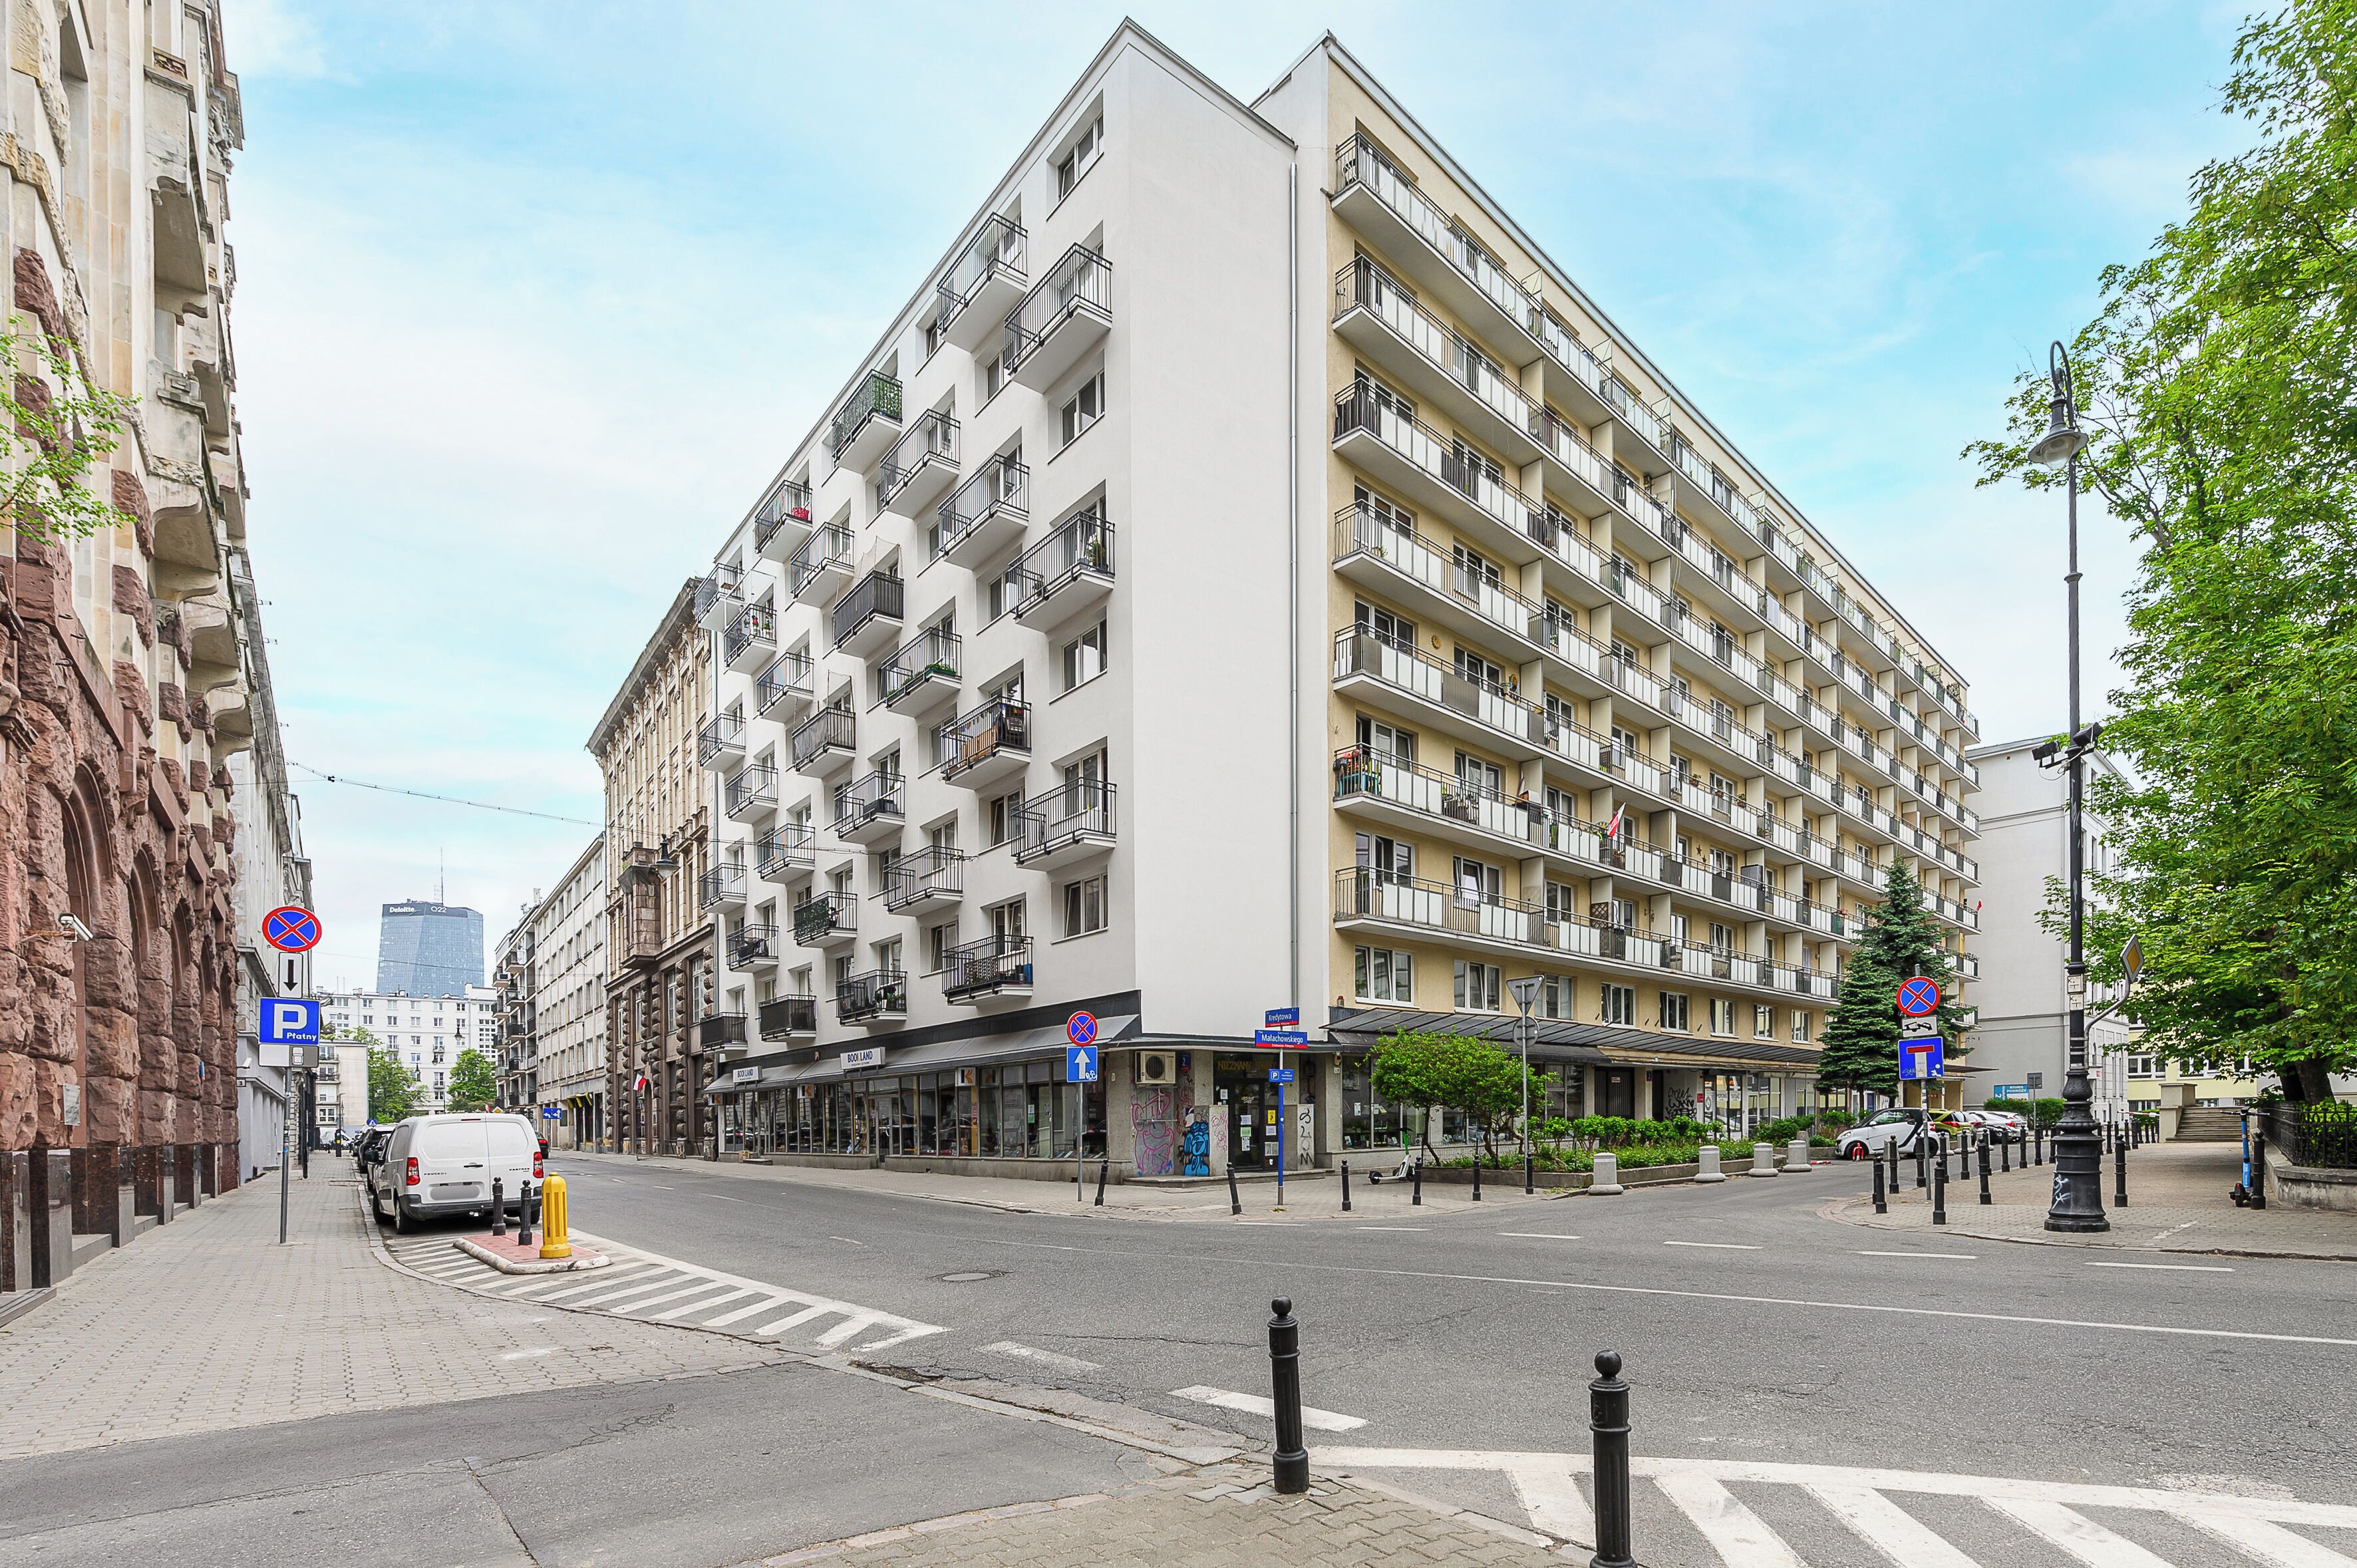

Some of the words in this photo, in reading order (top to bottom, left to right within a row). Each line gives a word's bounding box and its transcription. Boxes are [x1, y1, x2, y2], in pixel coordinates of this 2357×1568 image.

[273, 1003, 307, 1038] P
[1269, 1013, 1292, 1022] Kredytowa
[287, 1032, 317, 1042] Płatny
[1261, 1034, 1303, 1044] Małachowskiego
[1182, 1058, 1185, 1066] 2
[1217, 1060, 1251, 1070] NIEZNANY
